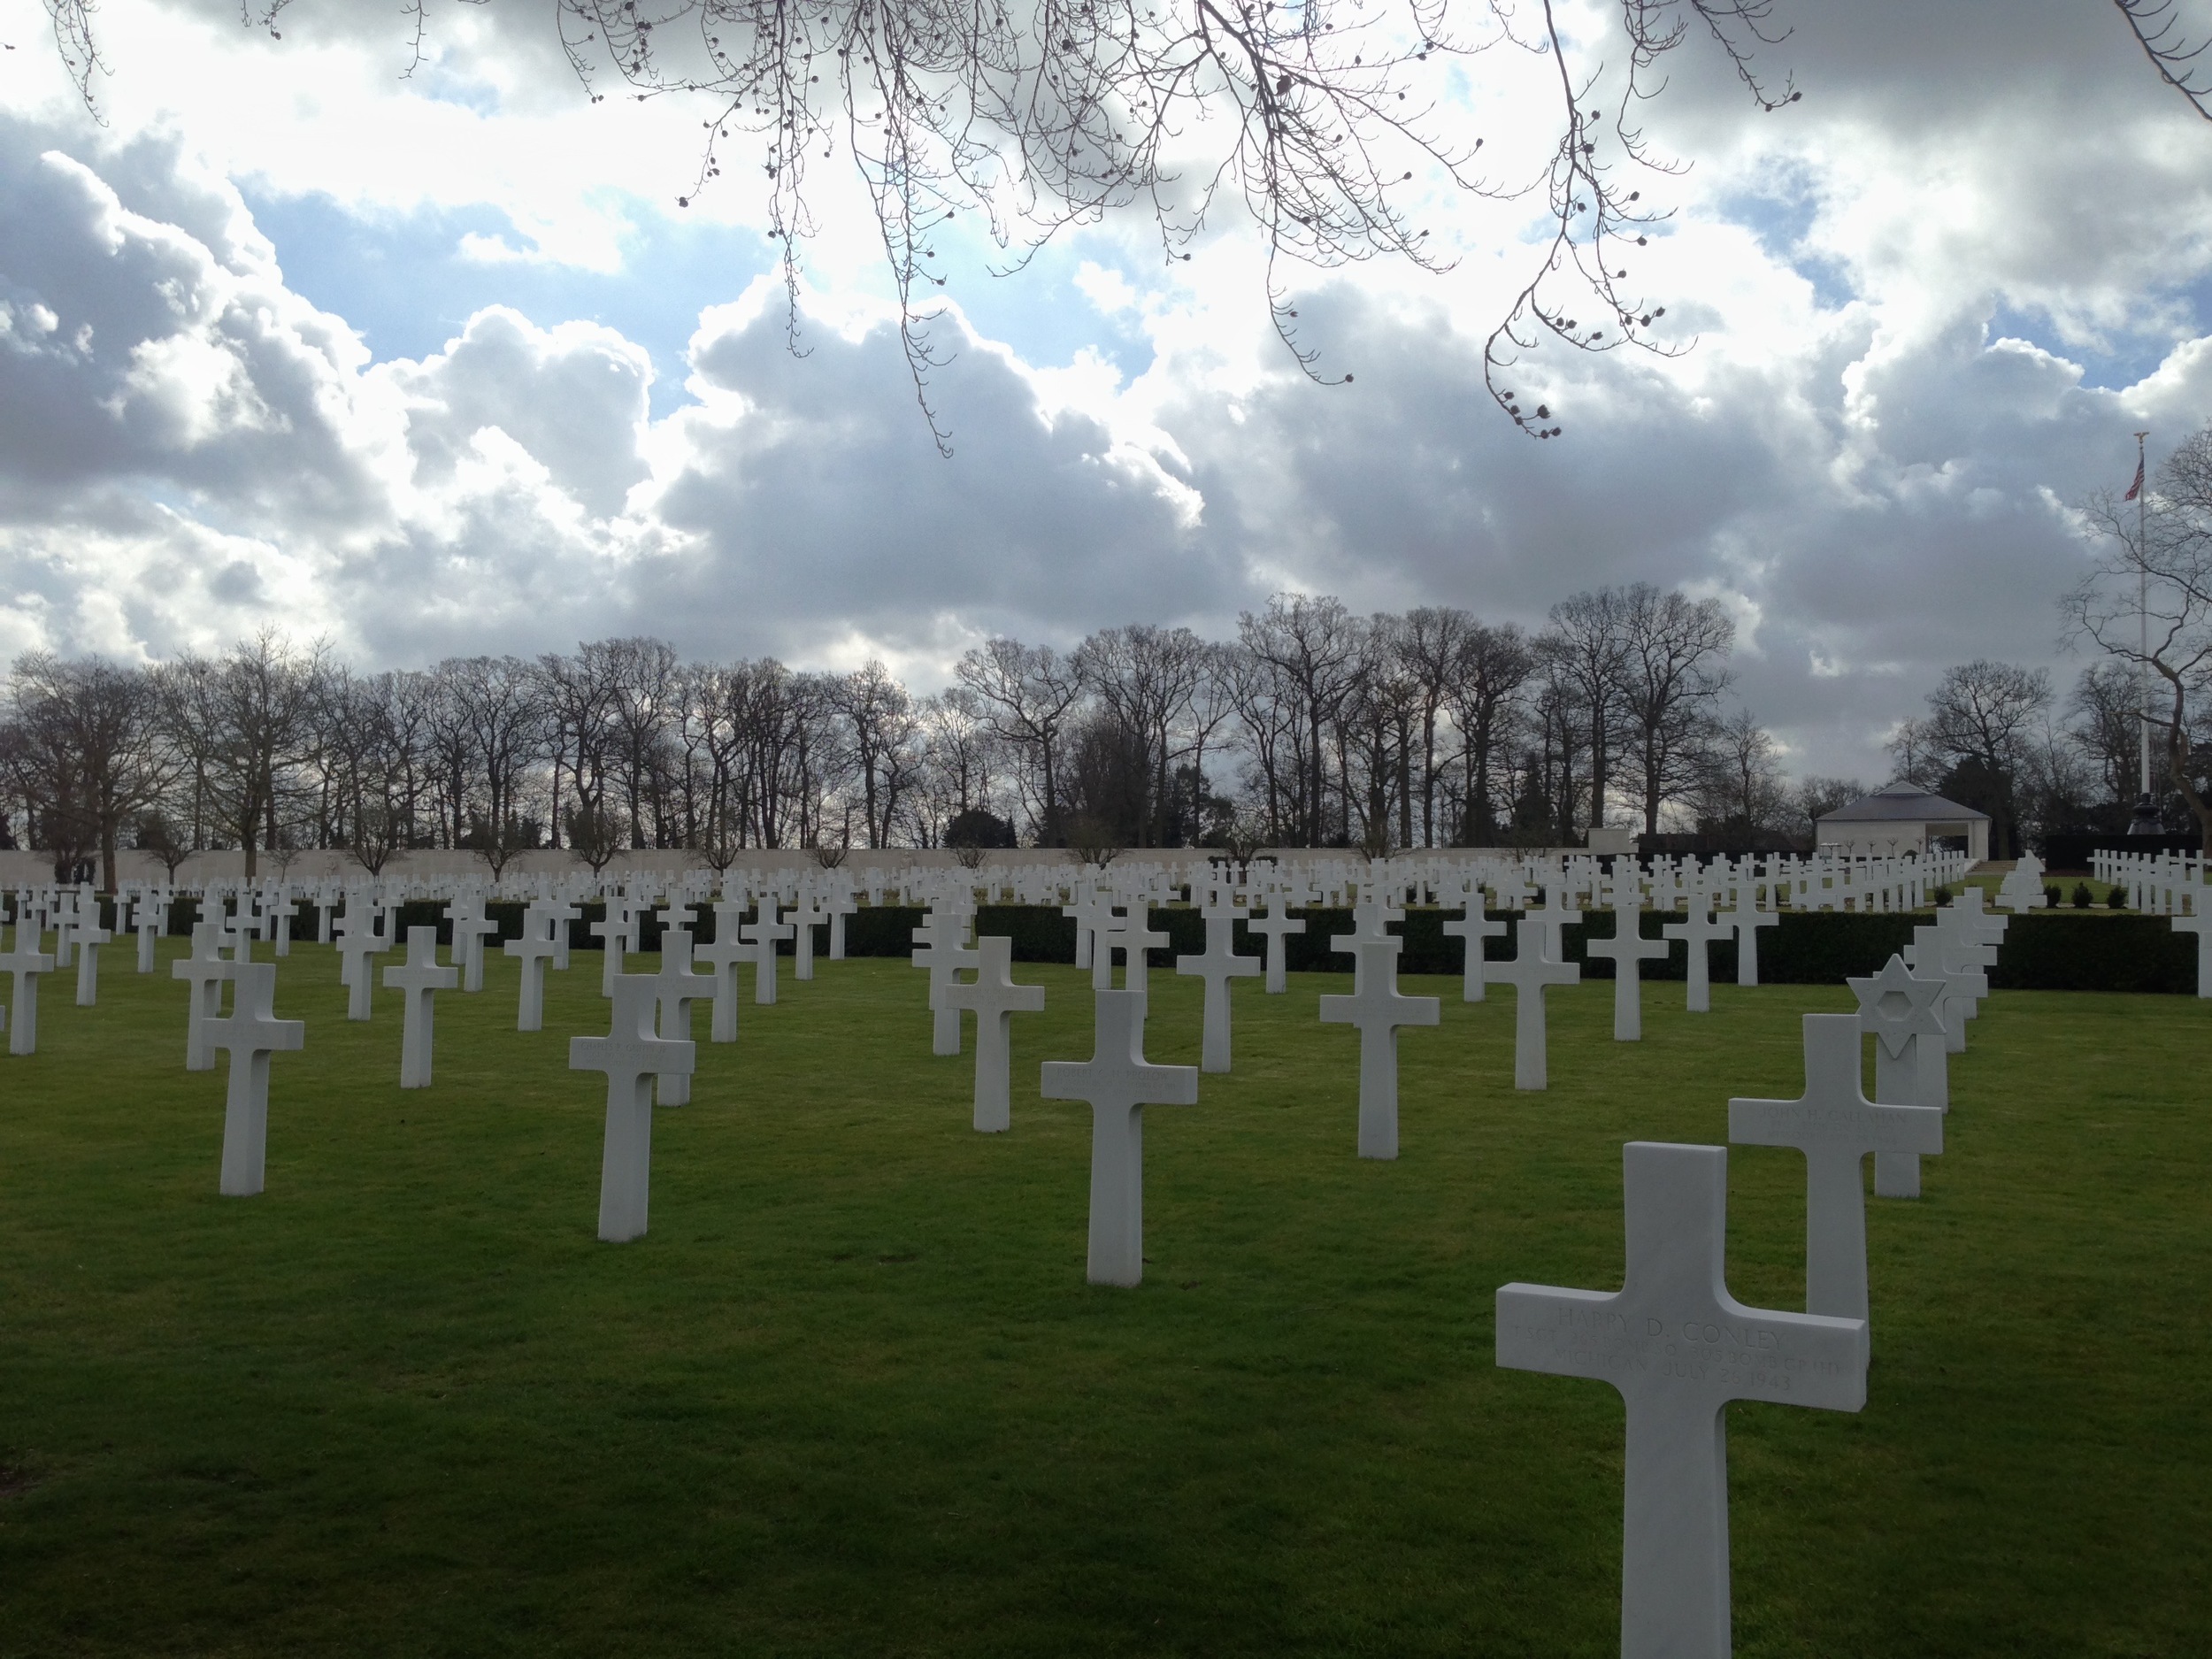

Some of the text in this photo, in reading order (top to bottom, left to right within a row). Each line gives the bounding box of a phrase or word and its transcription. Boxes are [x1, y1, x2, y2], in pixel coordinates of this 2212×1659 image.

[1557, 1308, 1786, 1351] HARRY D. CONLEY
[1554, 1347, 1648, 1372] MICHIGAN
[1663, 1362, 1709, 1380] JULY
[1748, 1371, 1792, 1392] 1943
[1690, 1346, 1723, 1363] 305
[1729, 1349, 1778, 1370] BOMB
